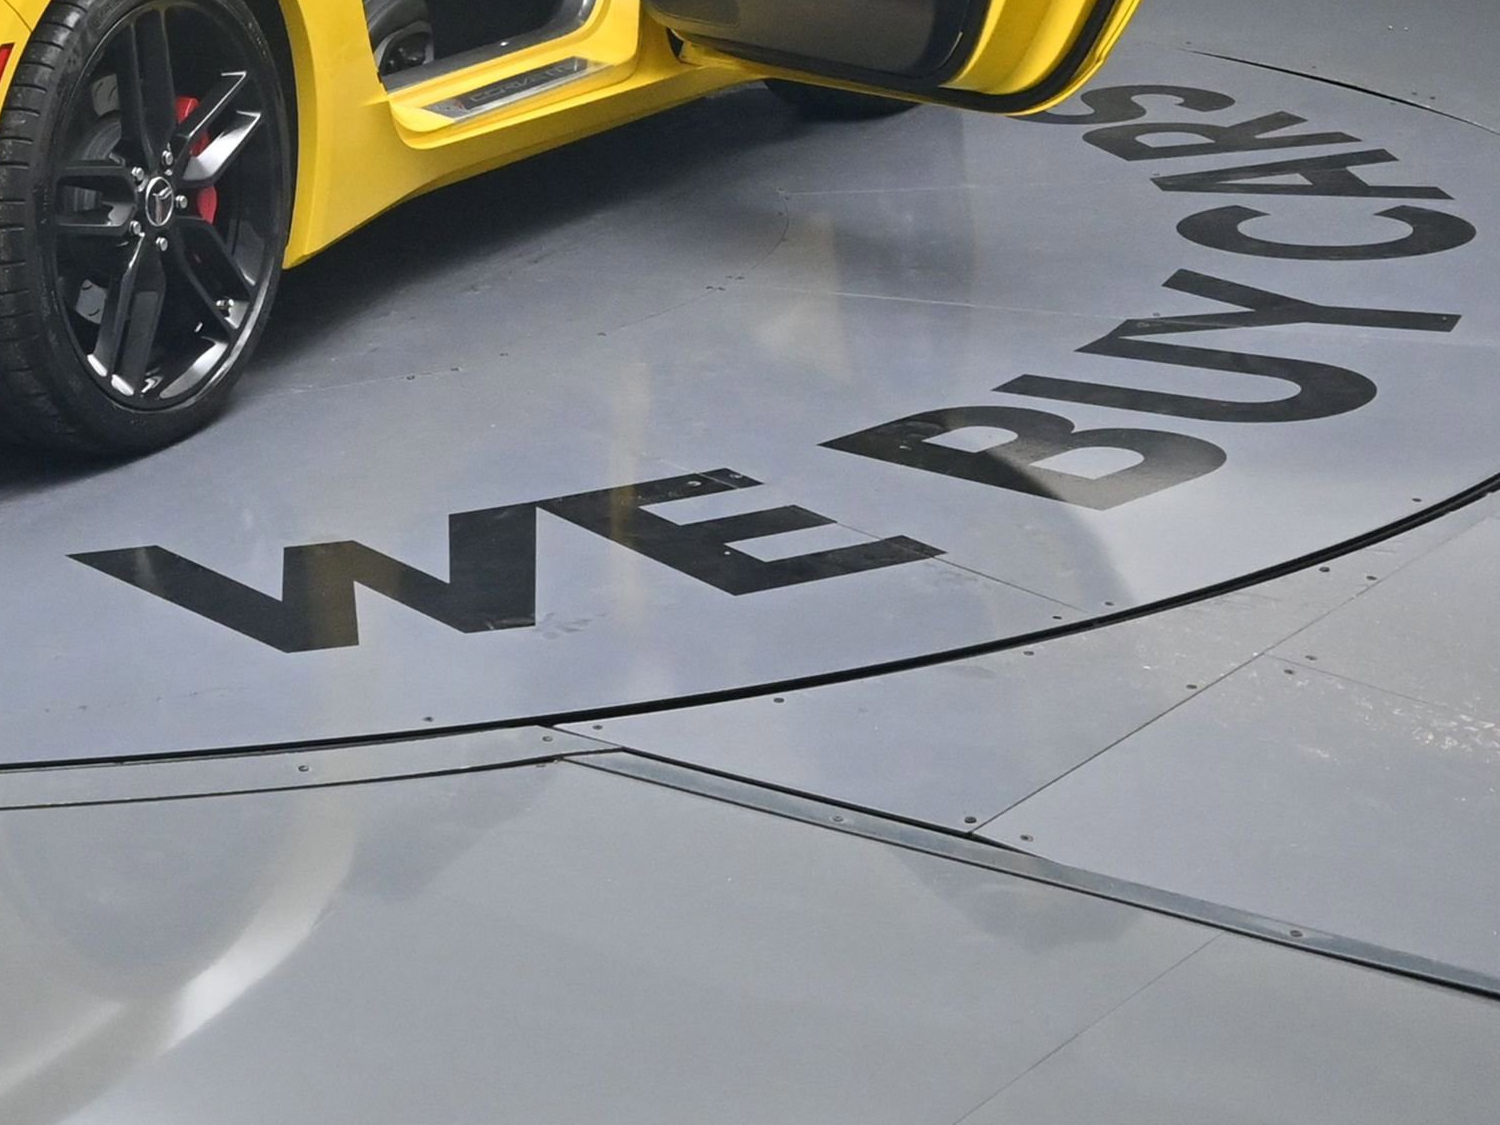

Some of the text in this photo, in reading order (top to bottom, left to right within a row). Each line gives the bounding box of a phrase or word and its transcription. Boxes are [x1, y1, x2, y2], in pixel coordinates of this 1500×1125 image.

[67, 83, 1477, 653] WE BUY CARS
